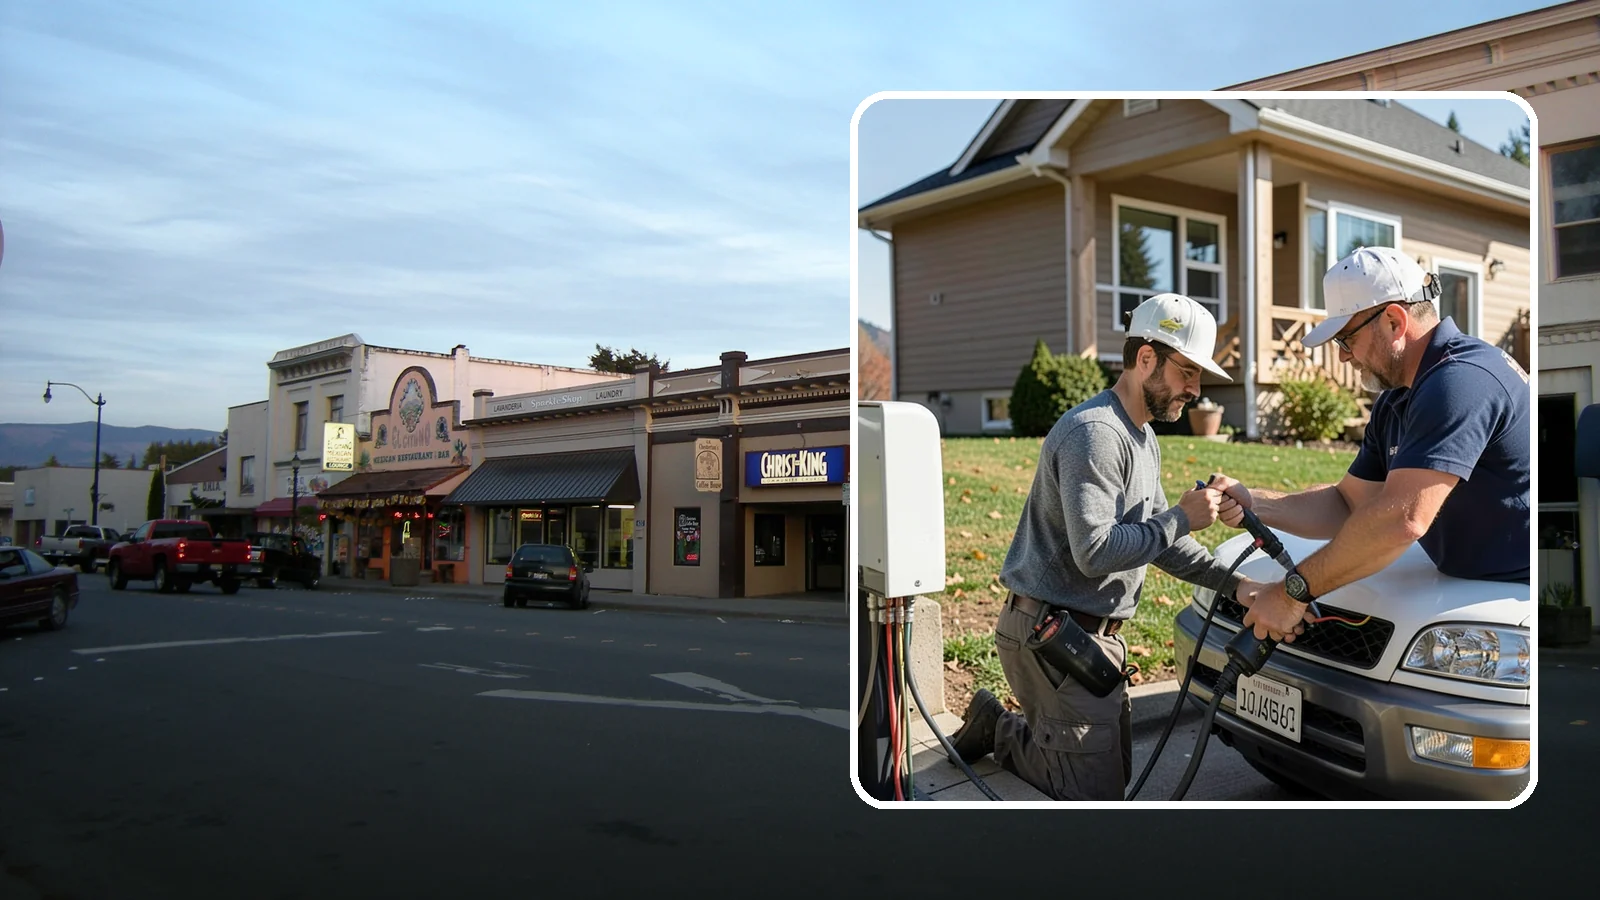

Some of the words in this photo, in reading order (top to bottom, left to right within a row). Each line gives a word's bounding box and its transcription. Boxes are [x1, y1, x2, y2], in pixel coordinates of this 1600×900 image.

[493, 402, 522, 412] LAVANDERIA
[531, 398, 561, 409] Sparkle
[562, 394, 582, 405] Shop
[595, 389, 623, 400] LAUNDRY
[397, 451, 433, 462] RESTAURANT
[437, 450, 450, 459] BAR
[760, 451, 797, 478] CHRIST
[798, 450, 827, 476] KING
[697, 480, 709, 488] Coffee
